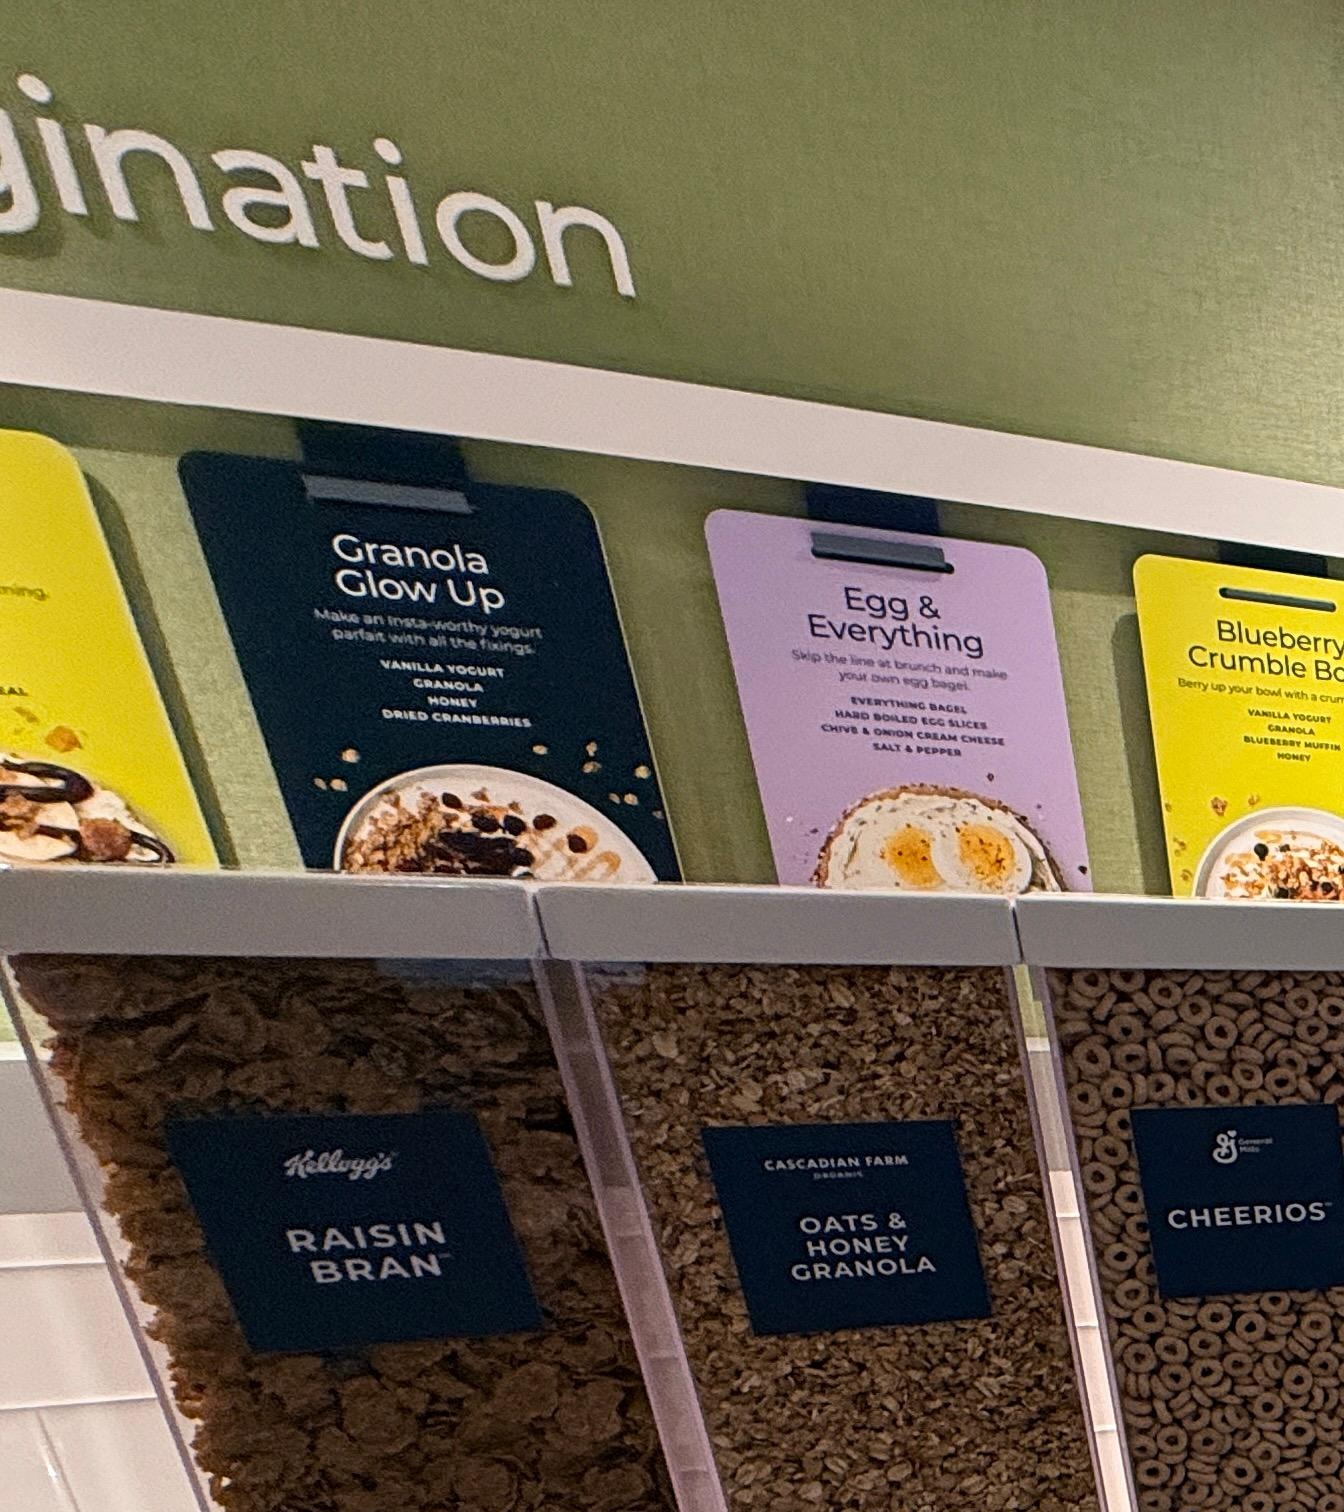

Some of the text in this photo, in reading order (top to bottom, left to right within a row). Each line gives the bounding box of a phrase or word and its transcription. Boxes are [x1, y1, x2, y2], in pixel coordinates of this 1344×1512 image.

[332, 534, 489, 574] Granola
[335, 568, 505, 614] Glow Up
[844, 587, 941, 621] Egg &
[313, 608, 360, 624] Make
[363, 614, 384, 625] an
[491, 626, 543, 639] yogurt
[331, 628, 536, 656] parfait with all the fixings.
[807, 614, 984, 659] Everything
[380, 659, 504, 678] VANILLA YOGURT
[791, 649, 1008, 680] Skip the line at brunch and make
[1188, 645, 1306, 678] Crumble
[413, 678, 484, 693] GRANOLA
[839, 671, 867, 682] your
[871, 675, 900, 685] own
[903, 679, 929, 690] egg
[1178, 677, 1208, 692] Berry
[1211, 682, 1226, 693] up
[1228, 684, 1253, 695] your
[1256, 686, 1282, 698] bowl
[1285, 689, 1308, 701] with
[427, 695, 478, 708] HONEY
[850, 696, 967, 714] EVERYTHING BAGEL
[381, 708, 532, 728] DRIED CRANBERRIES
[835, 710, 988, 730] HARD BOILED EGG SLICES
[1248, 708, 1332, 724] VANILLA YOGURT
[821, 724, 858, 735] CHIVE
[873, 728, 914, 740] ONION
[916, 731, 958, 742] CREAM
[961, 735, 1005, 746] CHEESE
[1268, 724, 1315, 736] GRANOLA
[873, 743, 962, 757] SALT & PEPPER
[1244, 735, 1341, 751] BLUEBERRY MUFFIN
[1277, 752, 1311, 762] HONEY
[283, 1149, 393, 1180] Kellogg's
[764, 1155, 909, 1171] CASCADIAN FARM
[799, 1212, 907, 1234] OATS &
[1168, 1202, 1326, 1229] CHEERIOS
[285, 1221, 446, 1253] RAISIN
[806, 1235, 908, 1257] HONEY
[309, 1253, 443, 1283] BRAN
[791, 1256, 936, 1281] GRANOLA
